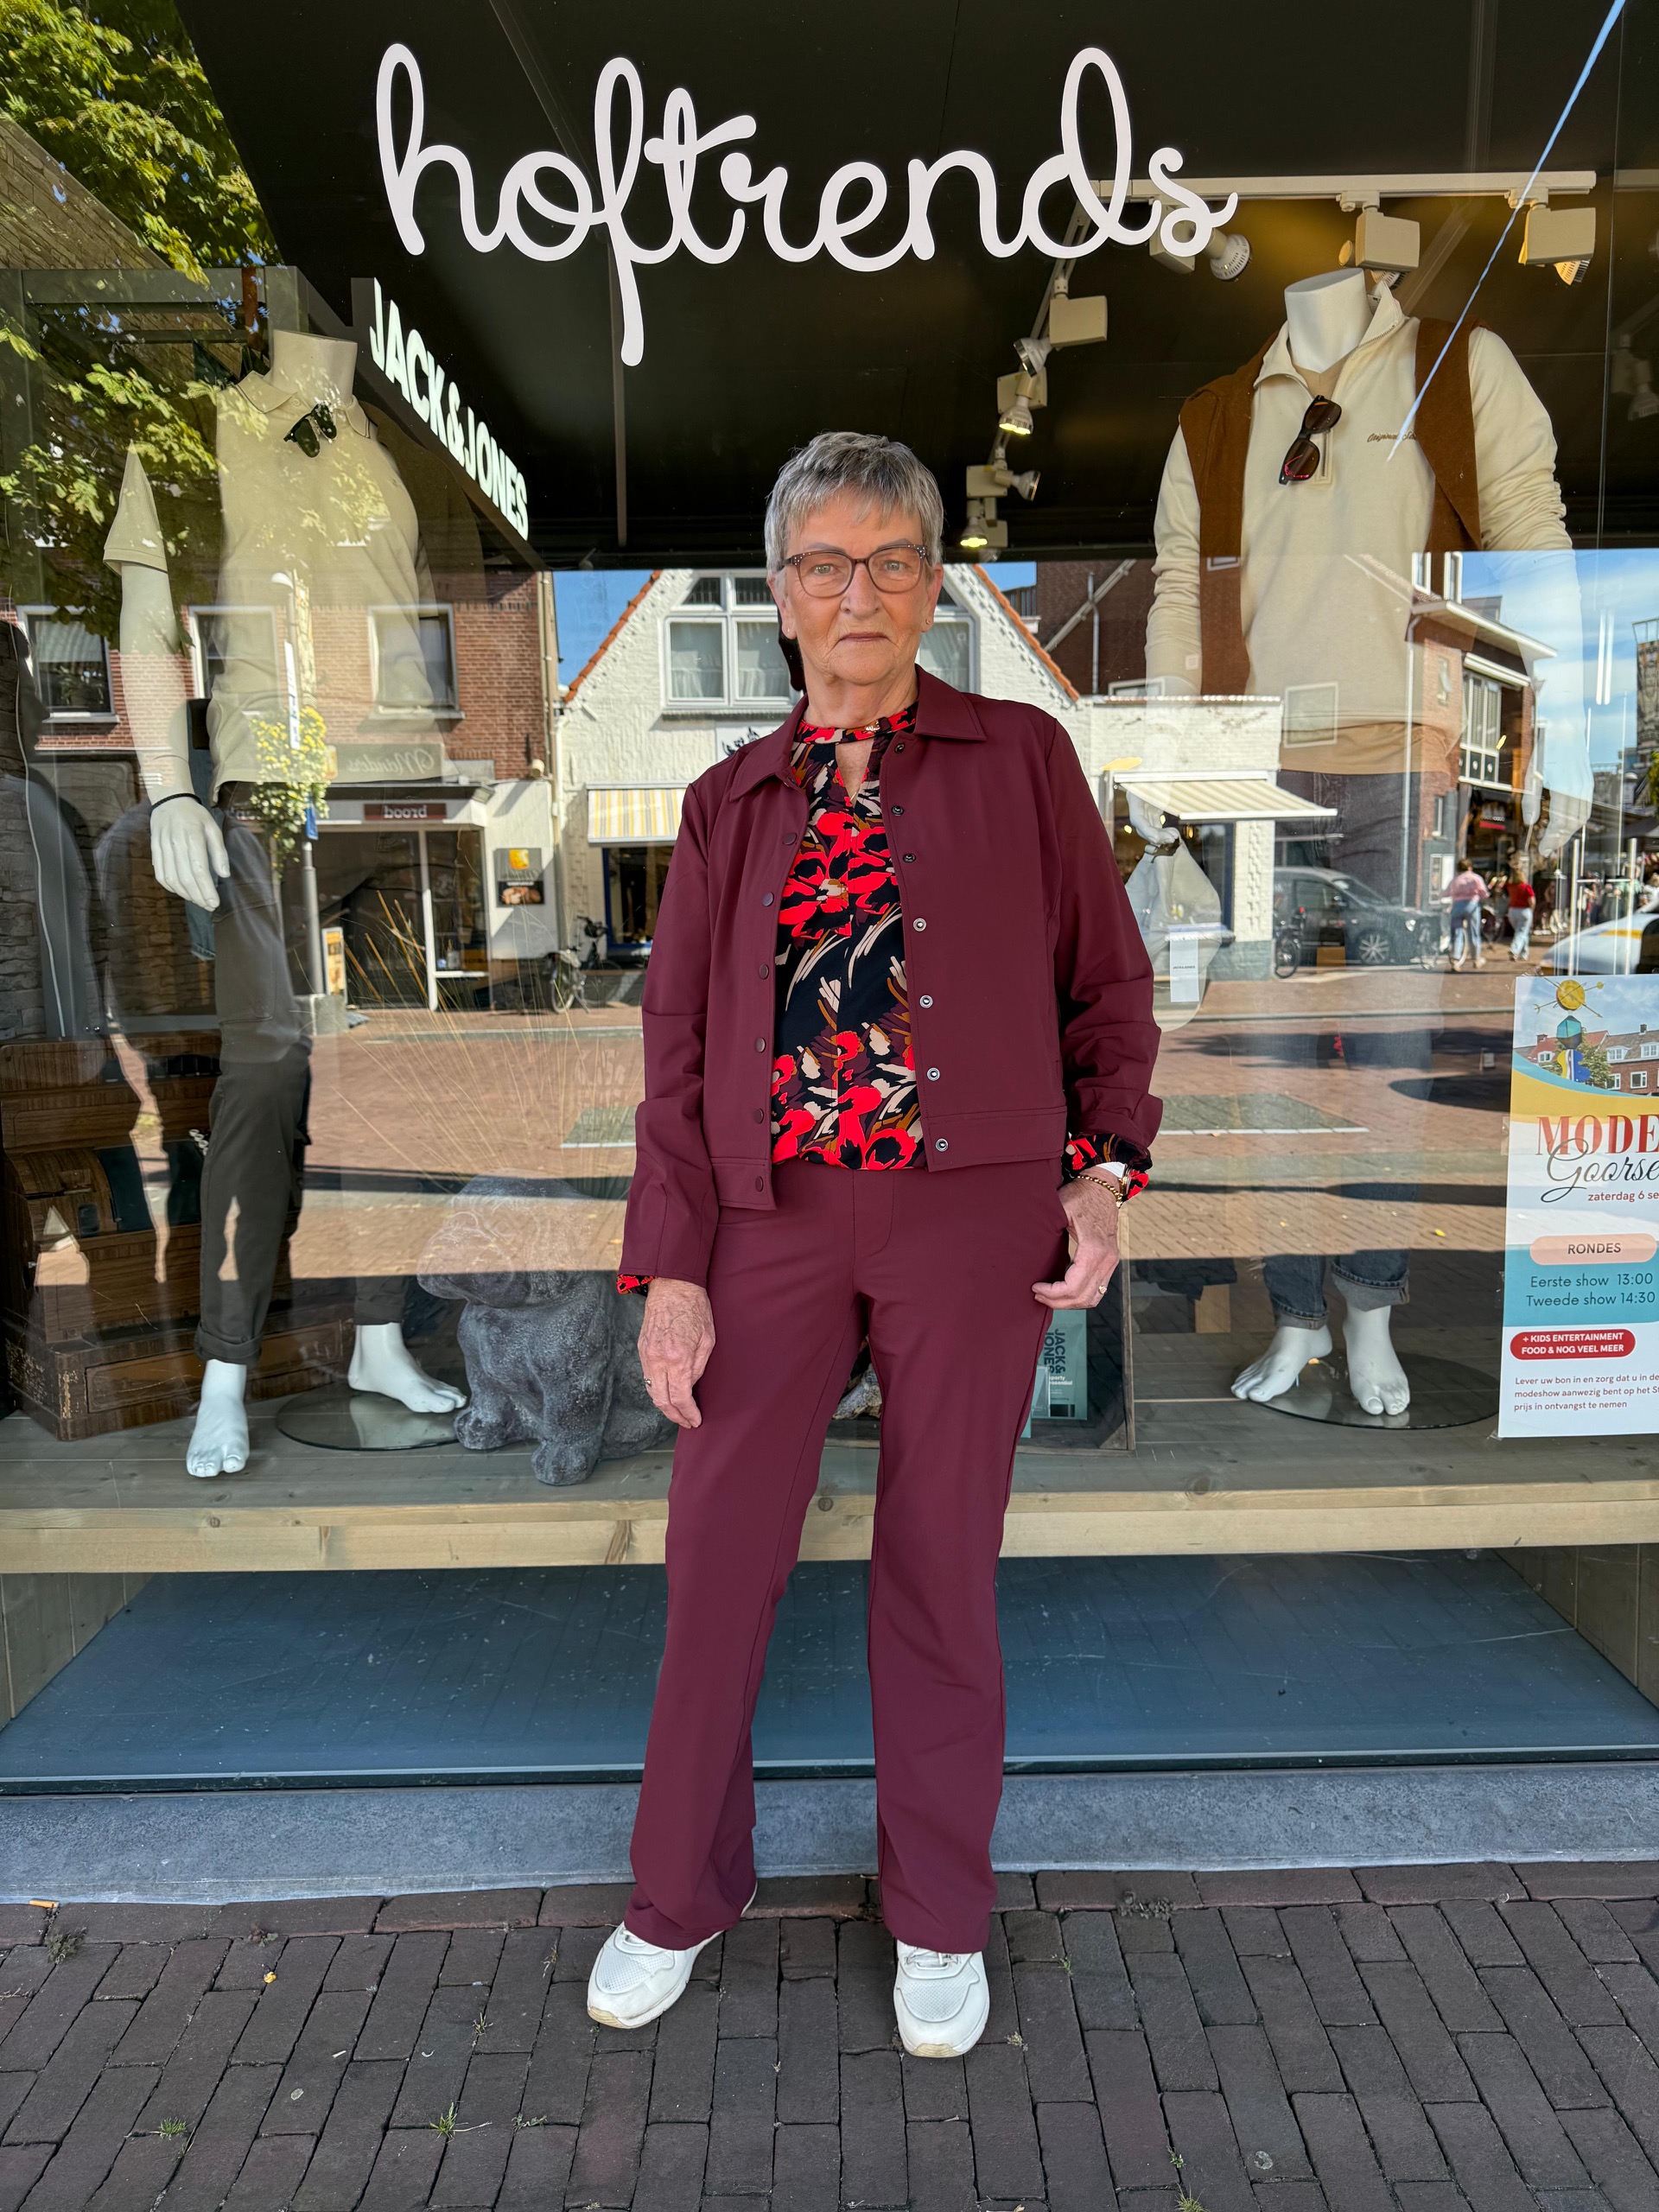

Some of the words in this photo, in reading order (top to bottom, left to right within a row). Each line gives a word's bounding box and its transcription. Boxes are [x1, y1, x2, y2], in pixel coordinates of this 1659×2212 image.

[377, 43, 1239, 366] hoftrends
[1535, 1114, 1659, 1155] MODE
[1587, 1191, 1636, 1203] zaterdag
[1637, 1190, 1645, 1200] 6
[1567, 1243, 1621, 1255] RONDES
[1530, 1275, 1572, 1287] Eerste
[1576, 1273, 1609, 1287] show
[1618, 1273, 1653, 1285] 13:00
[1526, 1292, 1580, 1306] Tweede
[1583, 1291, 1617, 1306] show
[1621, 1292, 1656, 1304] 14:30
[1530, 1334, 1551, 1343] KIDS
[1552, 1332, 1624, 1342] ENTERTAINMENT
[1521, 1346, 1547, 1355] FOOD
[1548, 1345, 1554, 1355] &
[1555, 1344, 1576, 1354] NOG
[1577, 1344, 1599, 1353] VEEL
[1599, 1344, 1624, 1352] MEER
[1595, 1376, 1614, 1384] zorg
[1616, 1374, 1630, 1382] dat
[1639, 1373, 1648, 1382] in
[1515, 1389, 1560, 1398] modeshow
[1561, 1388, 1601, 1398] aanwezig
[1637, 1386, 1650, 1395] het
[1514, 1403, 1533, 1413] prijs
[1544, 1401, 1586, 1411] ontvangst
[1588, 1401, 1598, 1409] te
